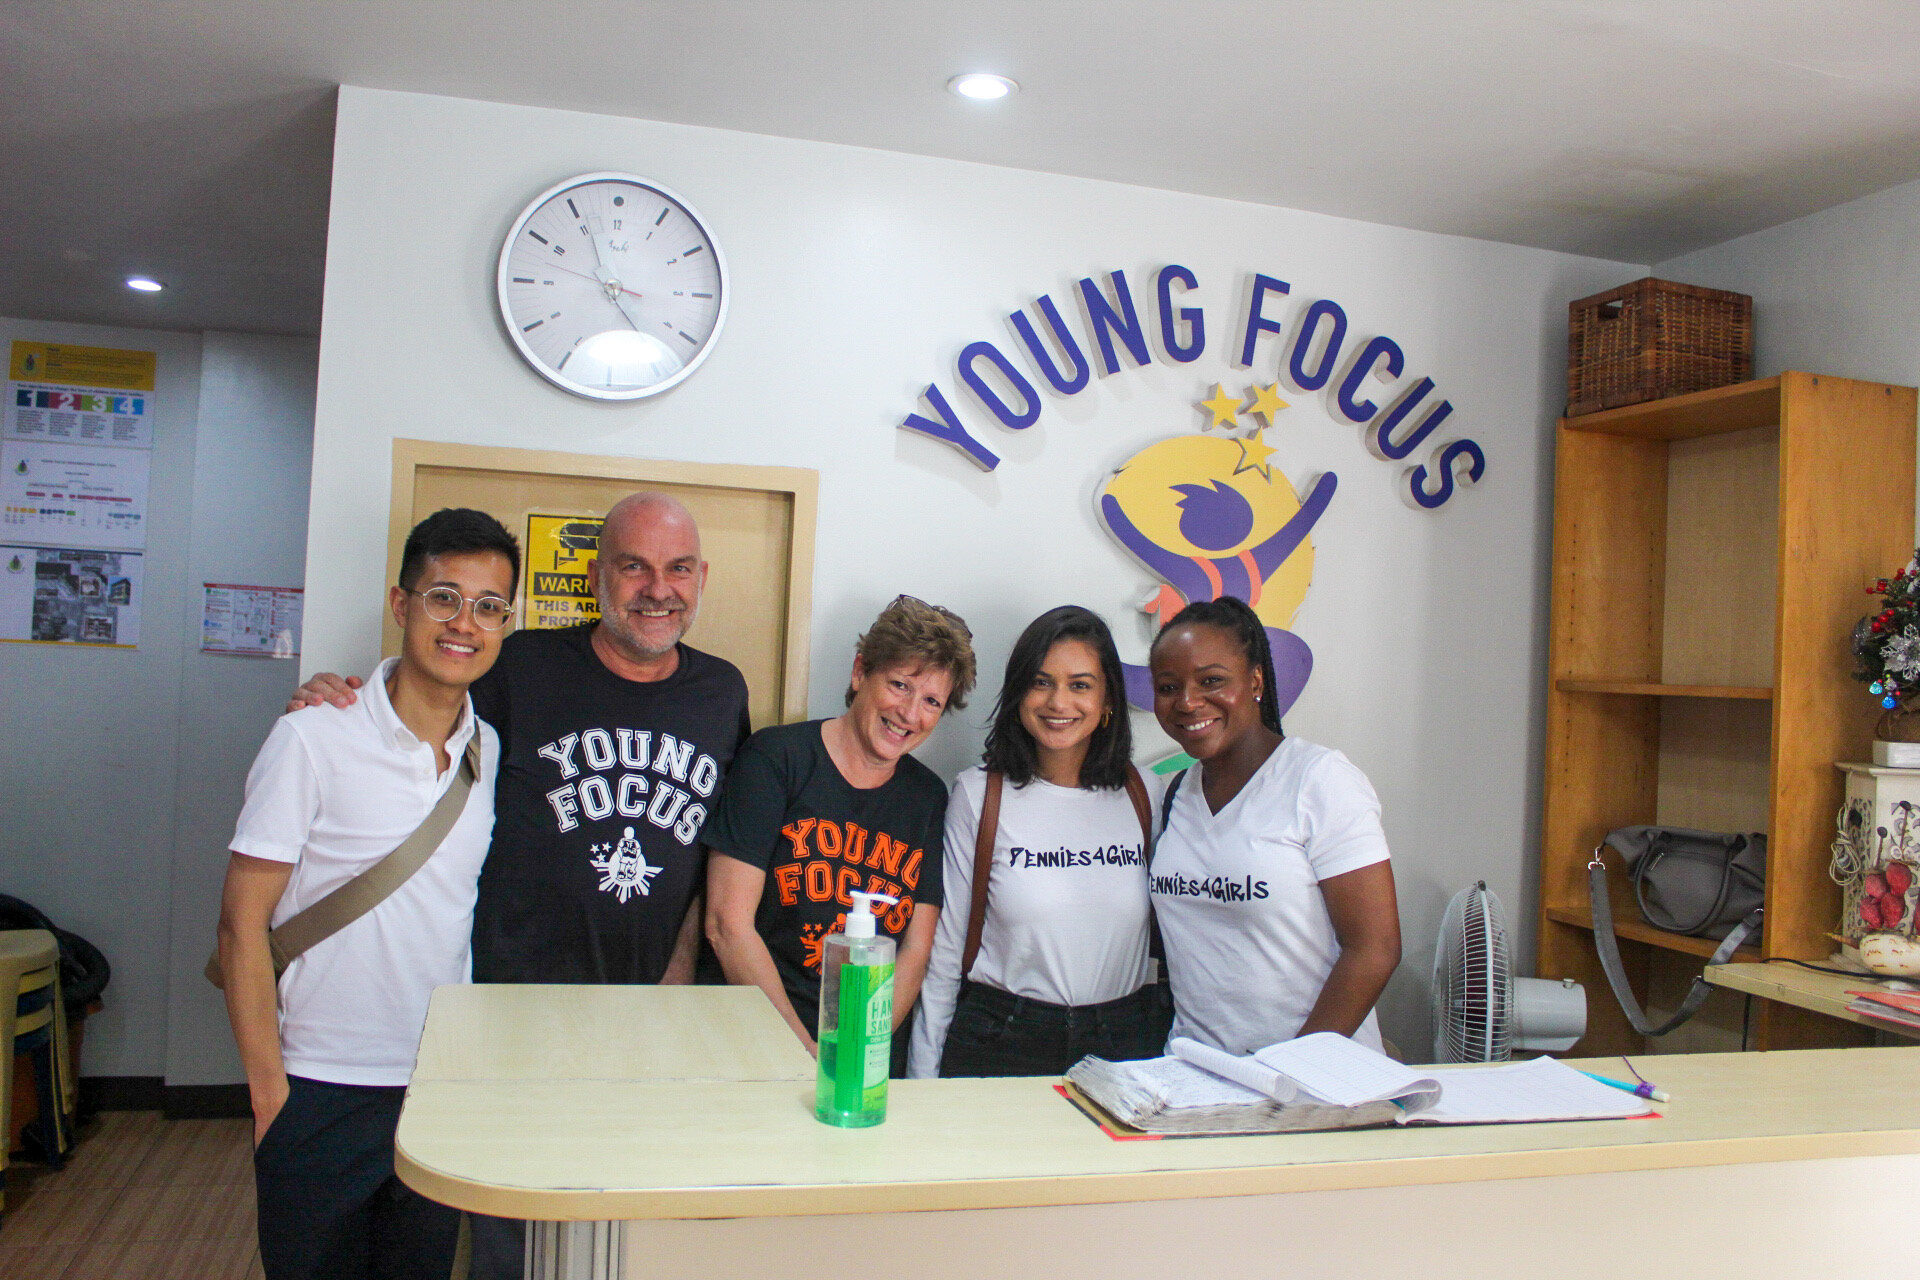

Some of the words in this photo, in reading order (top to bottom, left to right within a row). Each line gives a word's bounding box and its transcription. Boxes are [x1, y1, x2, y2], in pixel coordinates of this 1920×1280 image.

[613, 219, 622, 231] 12
[59, 392, 75, 410] 2
[91, 395, 107, 412] 3
[119, 397, 136, 416] 4
[903, 264, 1206, 473] YOUNG
[1239, 273, 1486, 509] FOCUS
[534, 599, 570, 612] THIS
[538, 727, 718, 798] YOUNG
[546, 773, 708, 846] FOCUS
[774, 860, 915, 934] FOCUS
